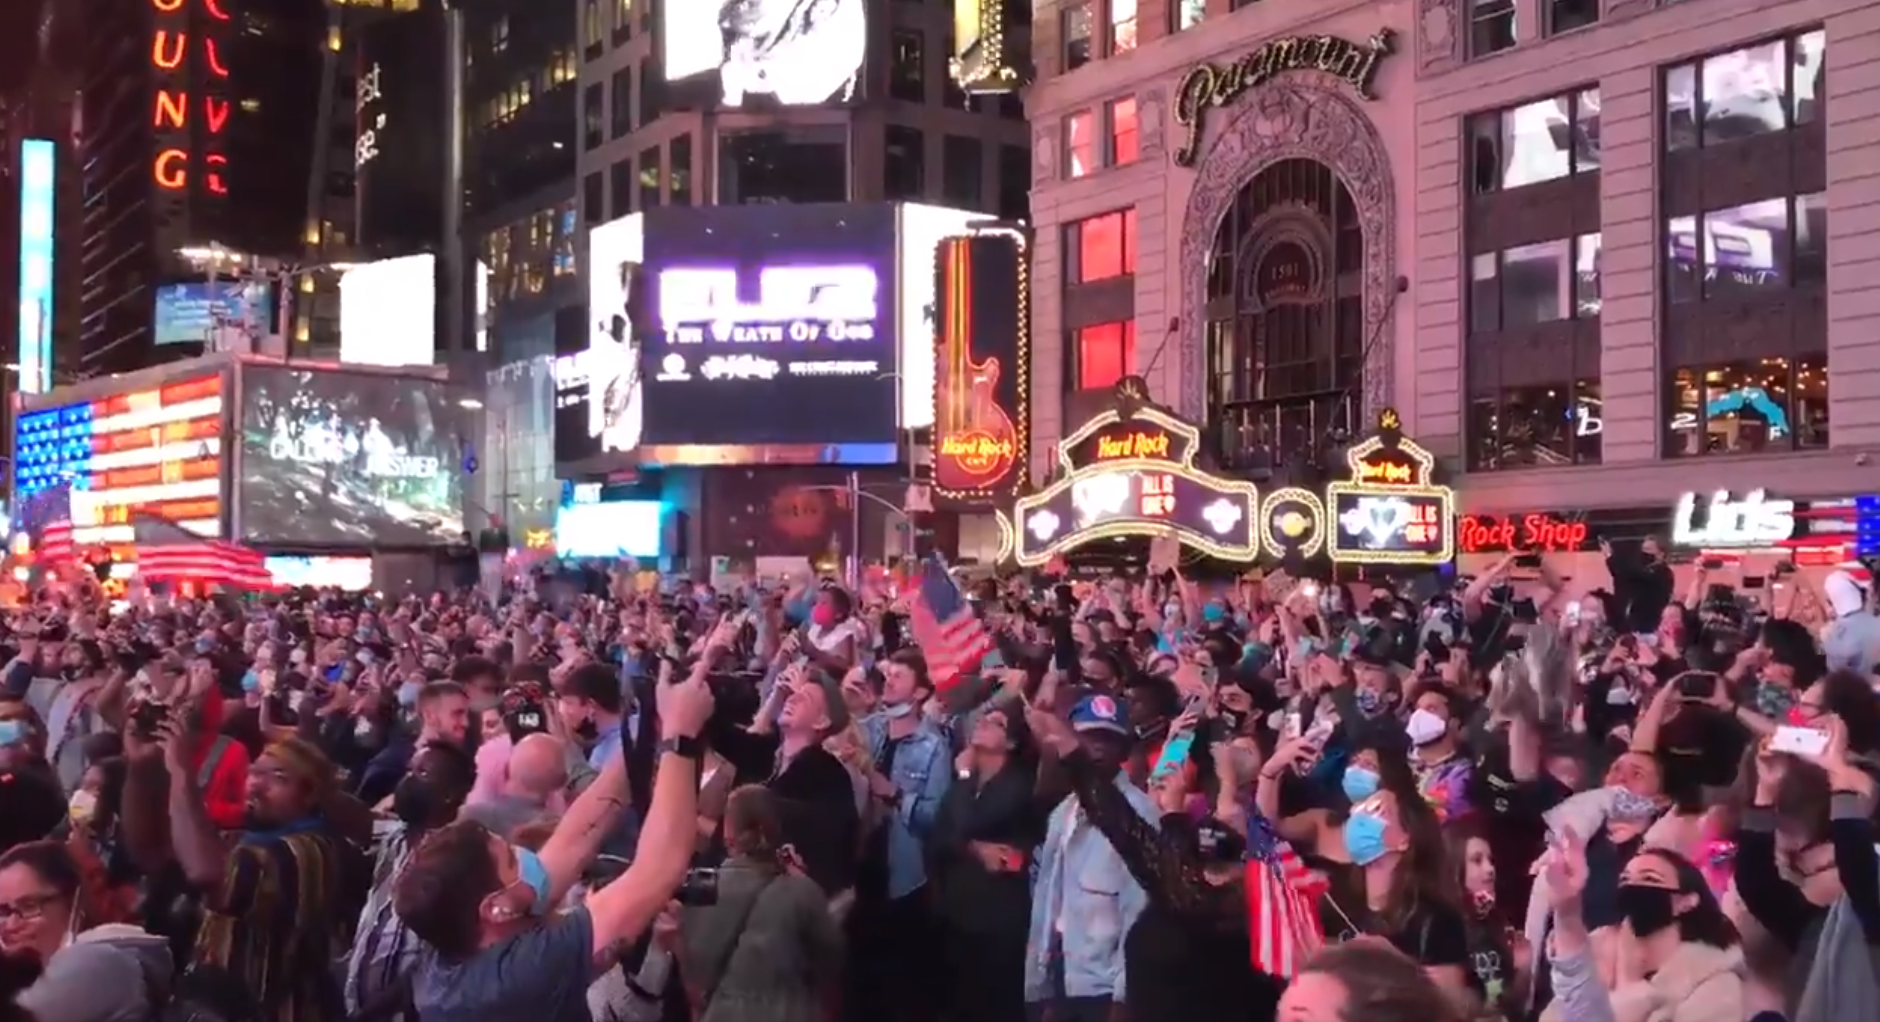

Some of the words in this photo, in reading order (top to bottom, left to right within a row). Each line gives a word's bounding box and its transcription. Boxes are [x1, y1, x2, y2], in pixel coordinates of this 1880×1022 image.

[1174, 27, 1398, 167] Paramount
[941, 436, 978, 455] Hard
[978, 437, 1012, 459] Rock
[1097, 432, 1134, 459] Hard
[1134, 429, 1168, 459] Rock
[1385, 461, 1411, 482] Rock
[1459, 514, 1518, 552] Rock
[1525, 513, 1587, 552] Shop
[1673, 487, 1794, 546] Lids
